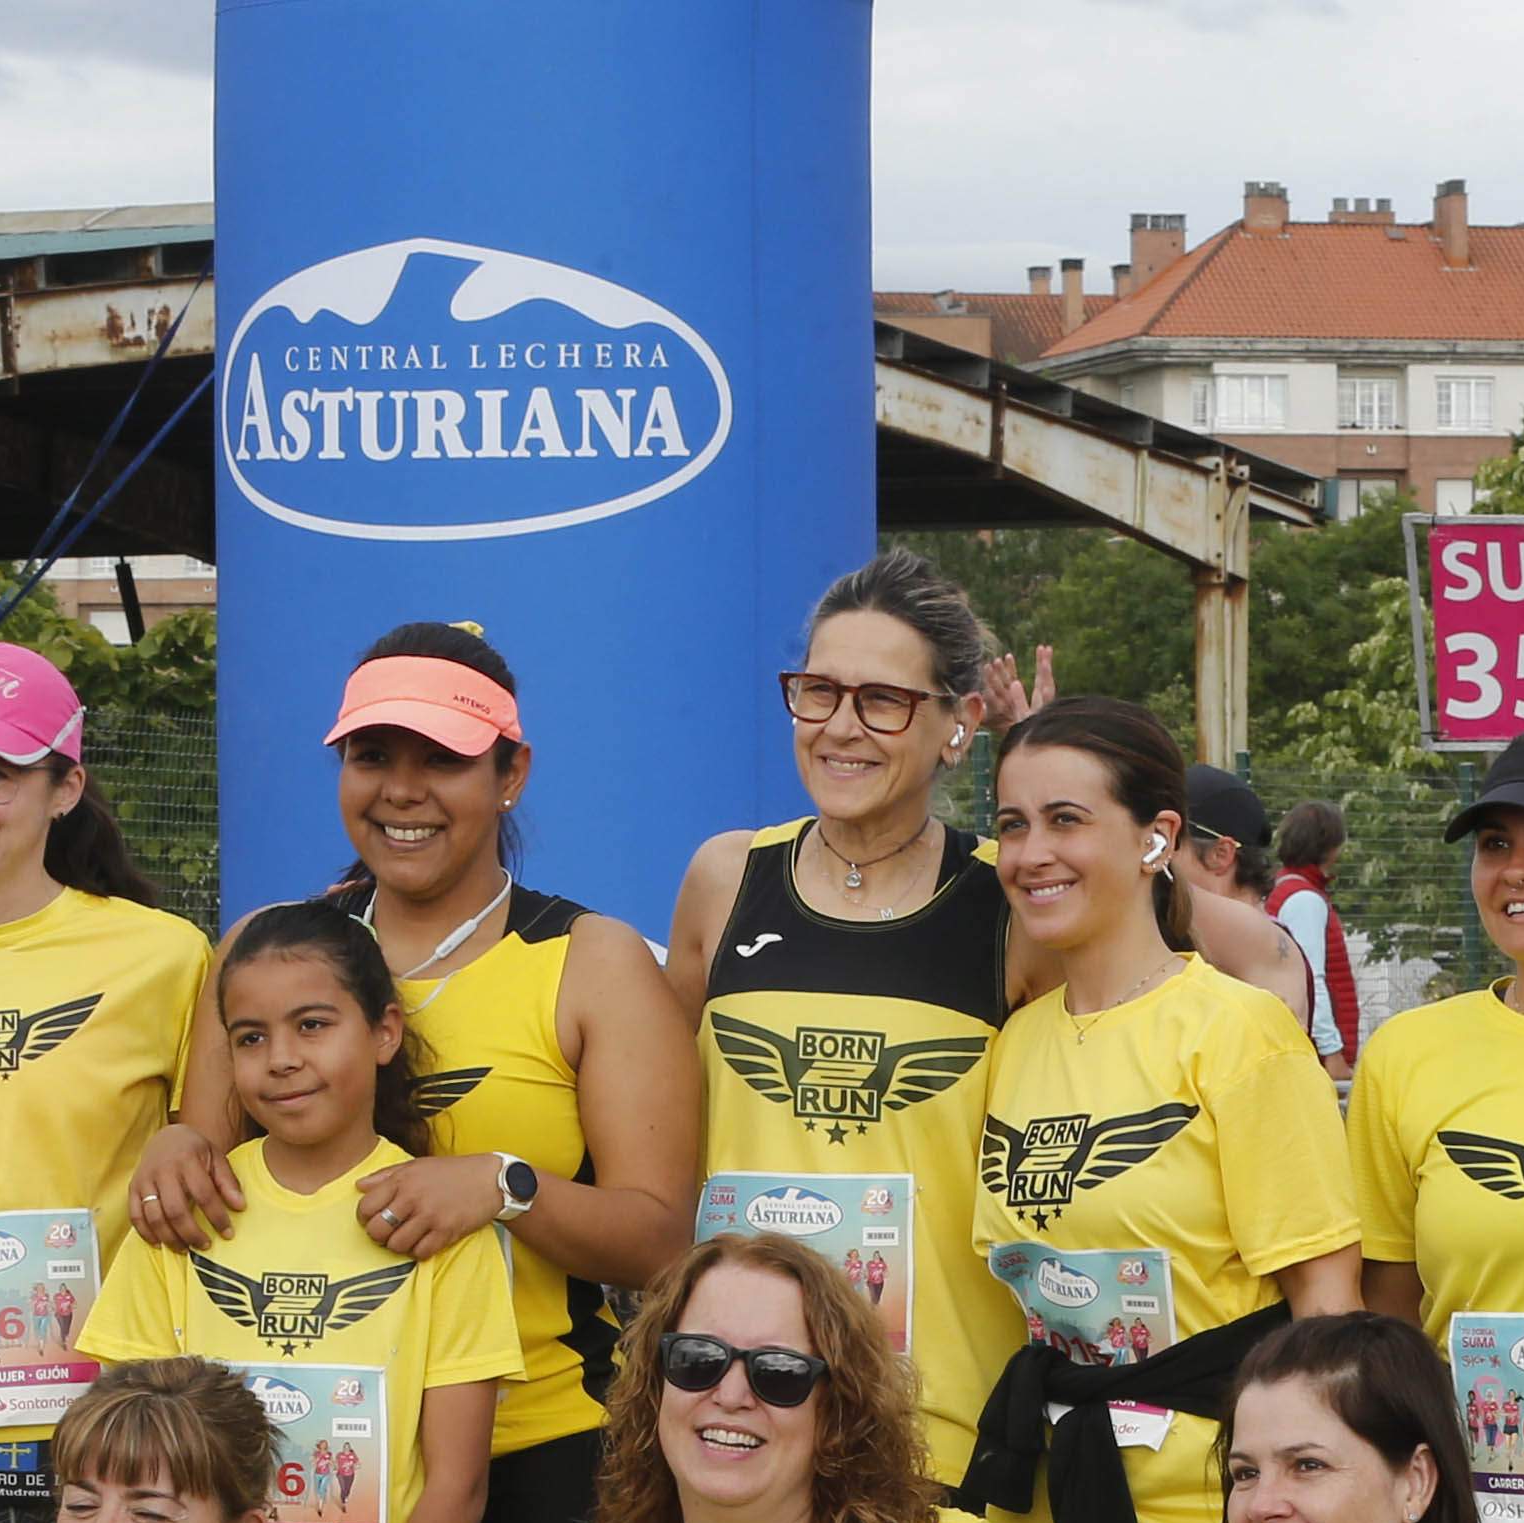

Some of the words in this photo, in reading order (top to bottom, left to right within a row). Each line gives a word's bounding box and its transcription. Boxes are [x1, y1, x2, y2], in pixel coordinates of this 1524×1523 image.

[284, 344, 449, 373] CENTRAL
[469, 341, 670, 370] LECHERA
[235, 352, 691, 461] ASTURIANA
[801, 1034, 878, 1060] BORN
[800, 1088, 876, 1115] RUN
[1026, 1120, 1082, 1145] BORN
[1013, 1174, 1070, 1201] RUN
[709, 1193, 735, 1206] SUMA
[866, 1190, 888, 1206] 20
[751, 1203, 836, 1225] ASTURIANA
[49, 1225, 72, 1240] 20
[1122, 1262, 1143, 1276] 20
[265, 1278, 323, 1295] BORN
[264, 1315, 320, 1334] RUN
[1462, 1336, 1496, 1348] SUMA
[36, 1367, 70, 1381] GIJÓN
[338, 1380, 359, 1396] 20
[27, 1474, 46, 1486] DE
[278, 1462, 306, 1497] 6
